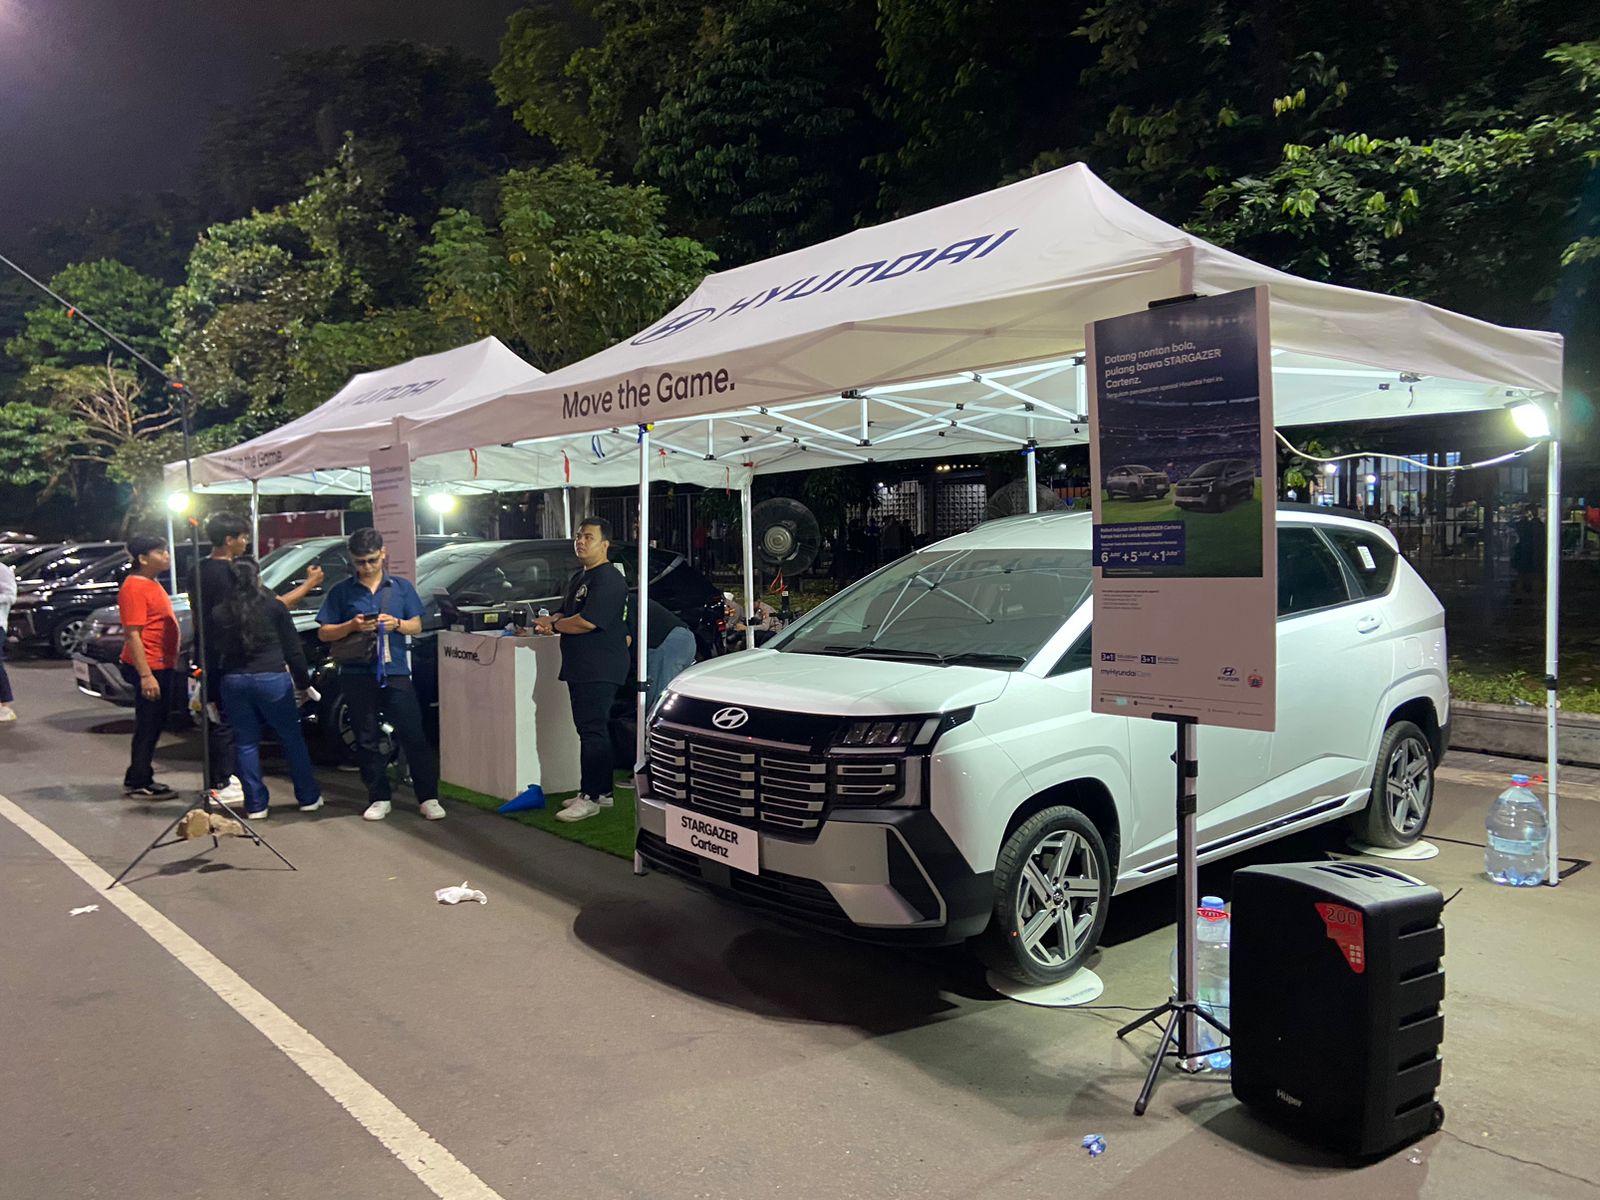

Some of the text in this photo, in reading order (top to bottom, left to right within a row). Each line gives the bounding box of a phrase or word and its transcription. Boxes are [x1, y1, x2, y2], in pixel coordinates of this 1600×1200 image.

[710, 228, 1019, 322] HYUNDAI
[1105, 341, 1196, 365] Datang nonton bola,
[1105, 349, 1222, 377] pulang bawa STARGAZER
[563, 368, 735, 420] Move the Game.
[1105, 376, 1141, 389] Cartenz.
[1101, 552, 1109, 563] 6
[444, 646, 480, 662] Welcome.
[681, 815, 738, 845] STARGAZER
[690, 835, 729, 858] Cartenz
[1327, 906, 1358, 926] 200
